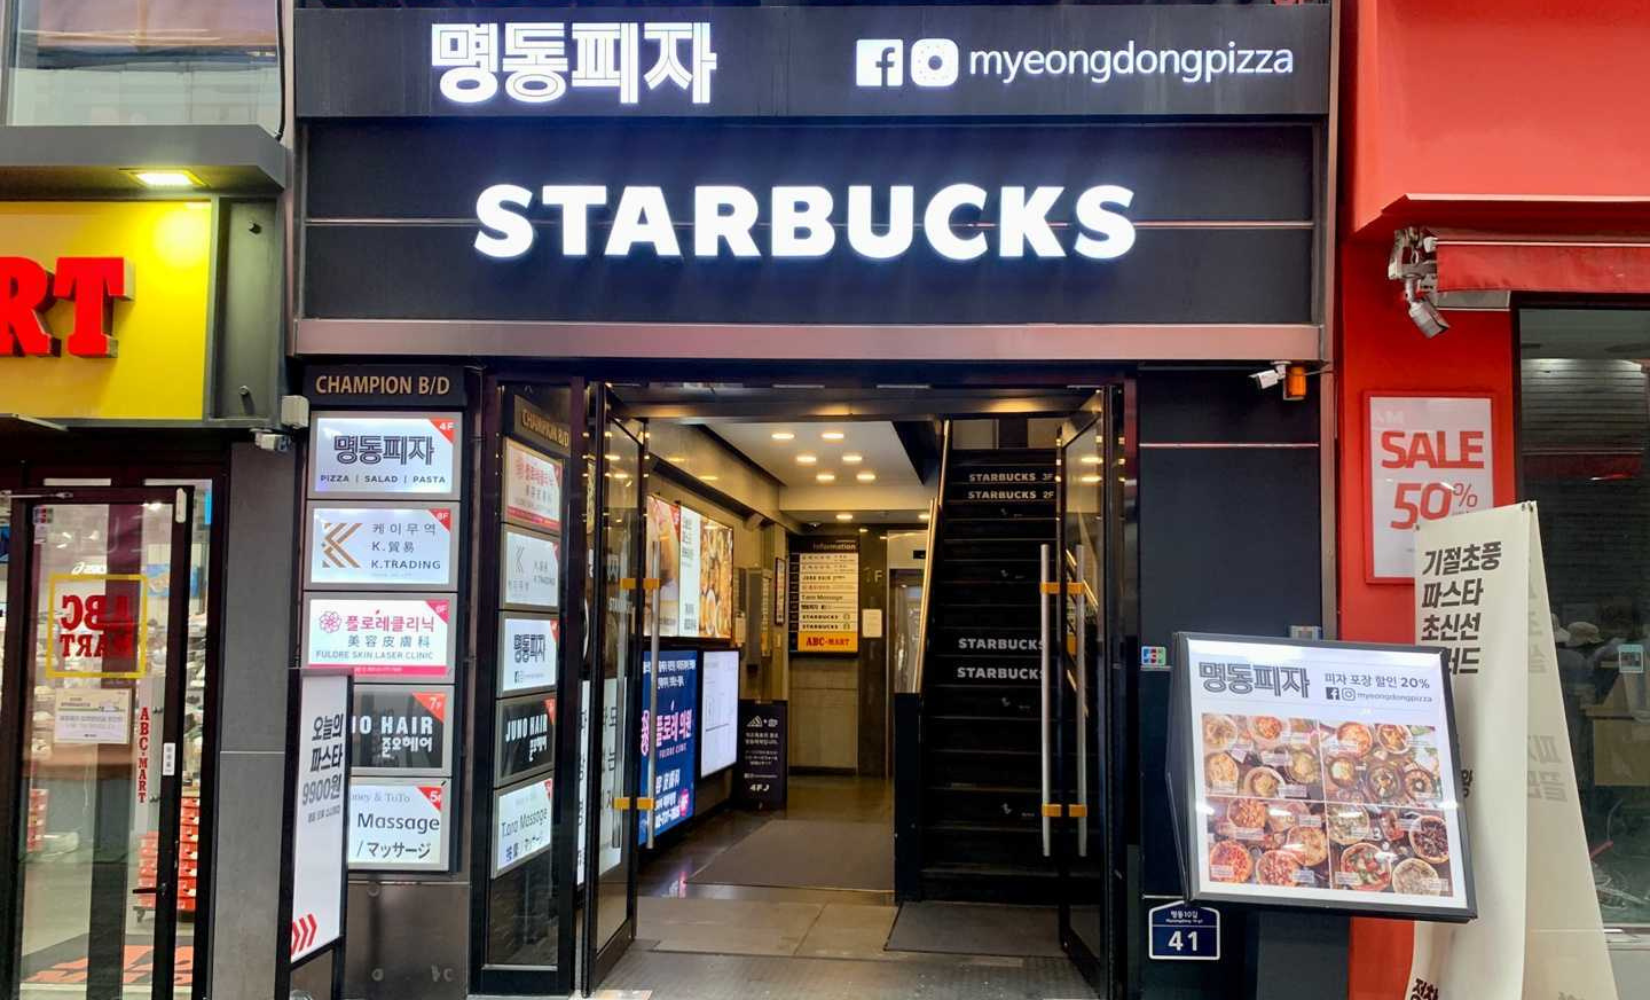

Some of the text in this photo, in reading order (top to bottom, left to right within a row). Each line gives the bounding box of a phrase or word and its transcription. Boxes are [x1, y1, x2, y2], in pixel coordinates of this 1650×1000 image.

[431, 22, 717, 104] 명동피자
[969, 41, 1294, 83] myeongdongpizza
[473, 183, 1137, 260] STARBUCKS
[315, 375, 450, 395] CHAMPION B/D
[439, 422, 455, 430] 4F
[334, 435, 435, 465] 명동피자
[1381, 431, 1484, 469] SALE
[364, 475, 398, 483] SALAD
[412, 475, 446, 483] PASTA
[969, 473, 1036, 482] STARBUCKS
[968, 490, 1036, 499] STARBUCKS
[1390, 482, 1478, 530] 50%
[372, 523, 436, 535] 케이무역
[370, 560, 441, 569] K.TRADING
[1422, 541, 1502, 577] 기절초풍
[1421, 578, 1484, 609] 파스타
[345, 615, 434, 632] 플로레클리닉
[1420, 612, 1481, 643] 초신선
[347, 635, 430, 648] 美容皮膚科
[352, 651, 373, 659] SKIN
[406, 652, 434, 660] CLINIC
[957, 667, 1043, 680] STARBUCK
[1199, 662, 1311, 699] 명동피자
[1325, 672, 1430, 689] 피자 포장 할인 20%
[312, 713, 344, 742] 오늘의
[381, 716, 433, 735] HAIR
[505, 717, 528, 743] JUNO
[310, 743, 343, 772] 파스타
[302, 773, 342, 806] 9900원
[357, 812, 440, 835] Massage
[367, 842, 431, 859] マッサージ
[1167, 930, 1198, 952] 41
